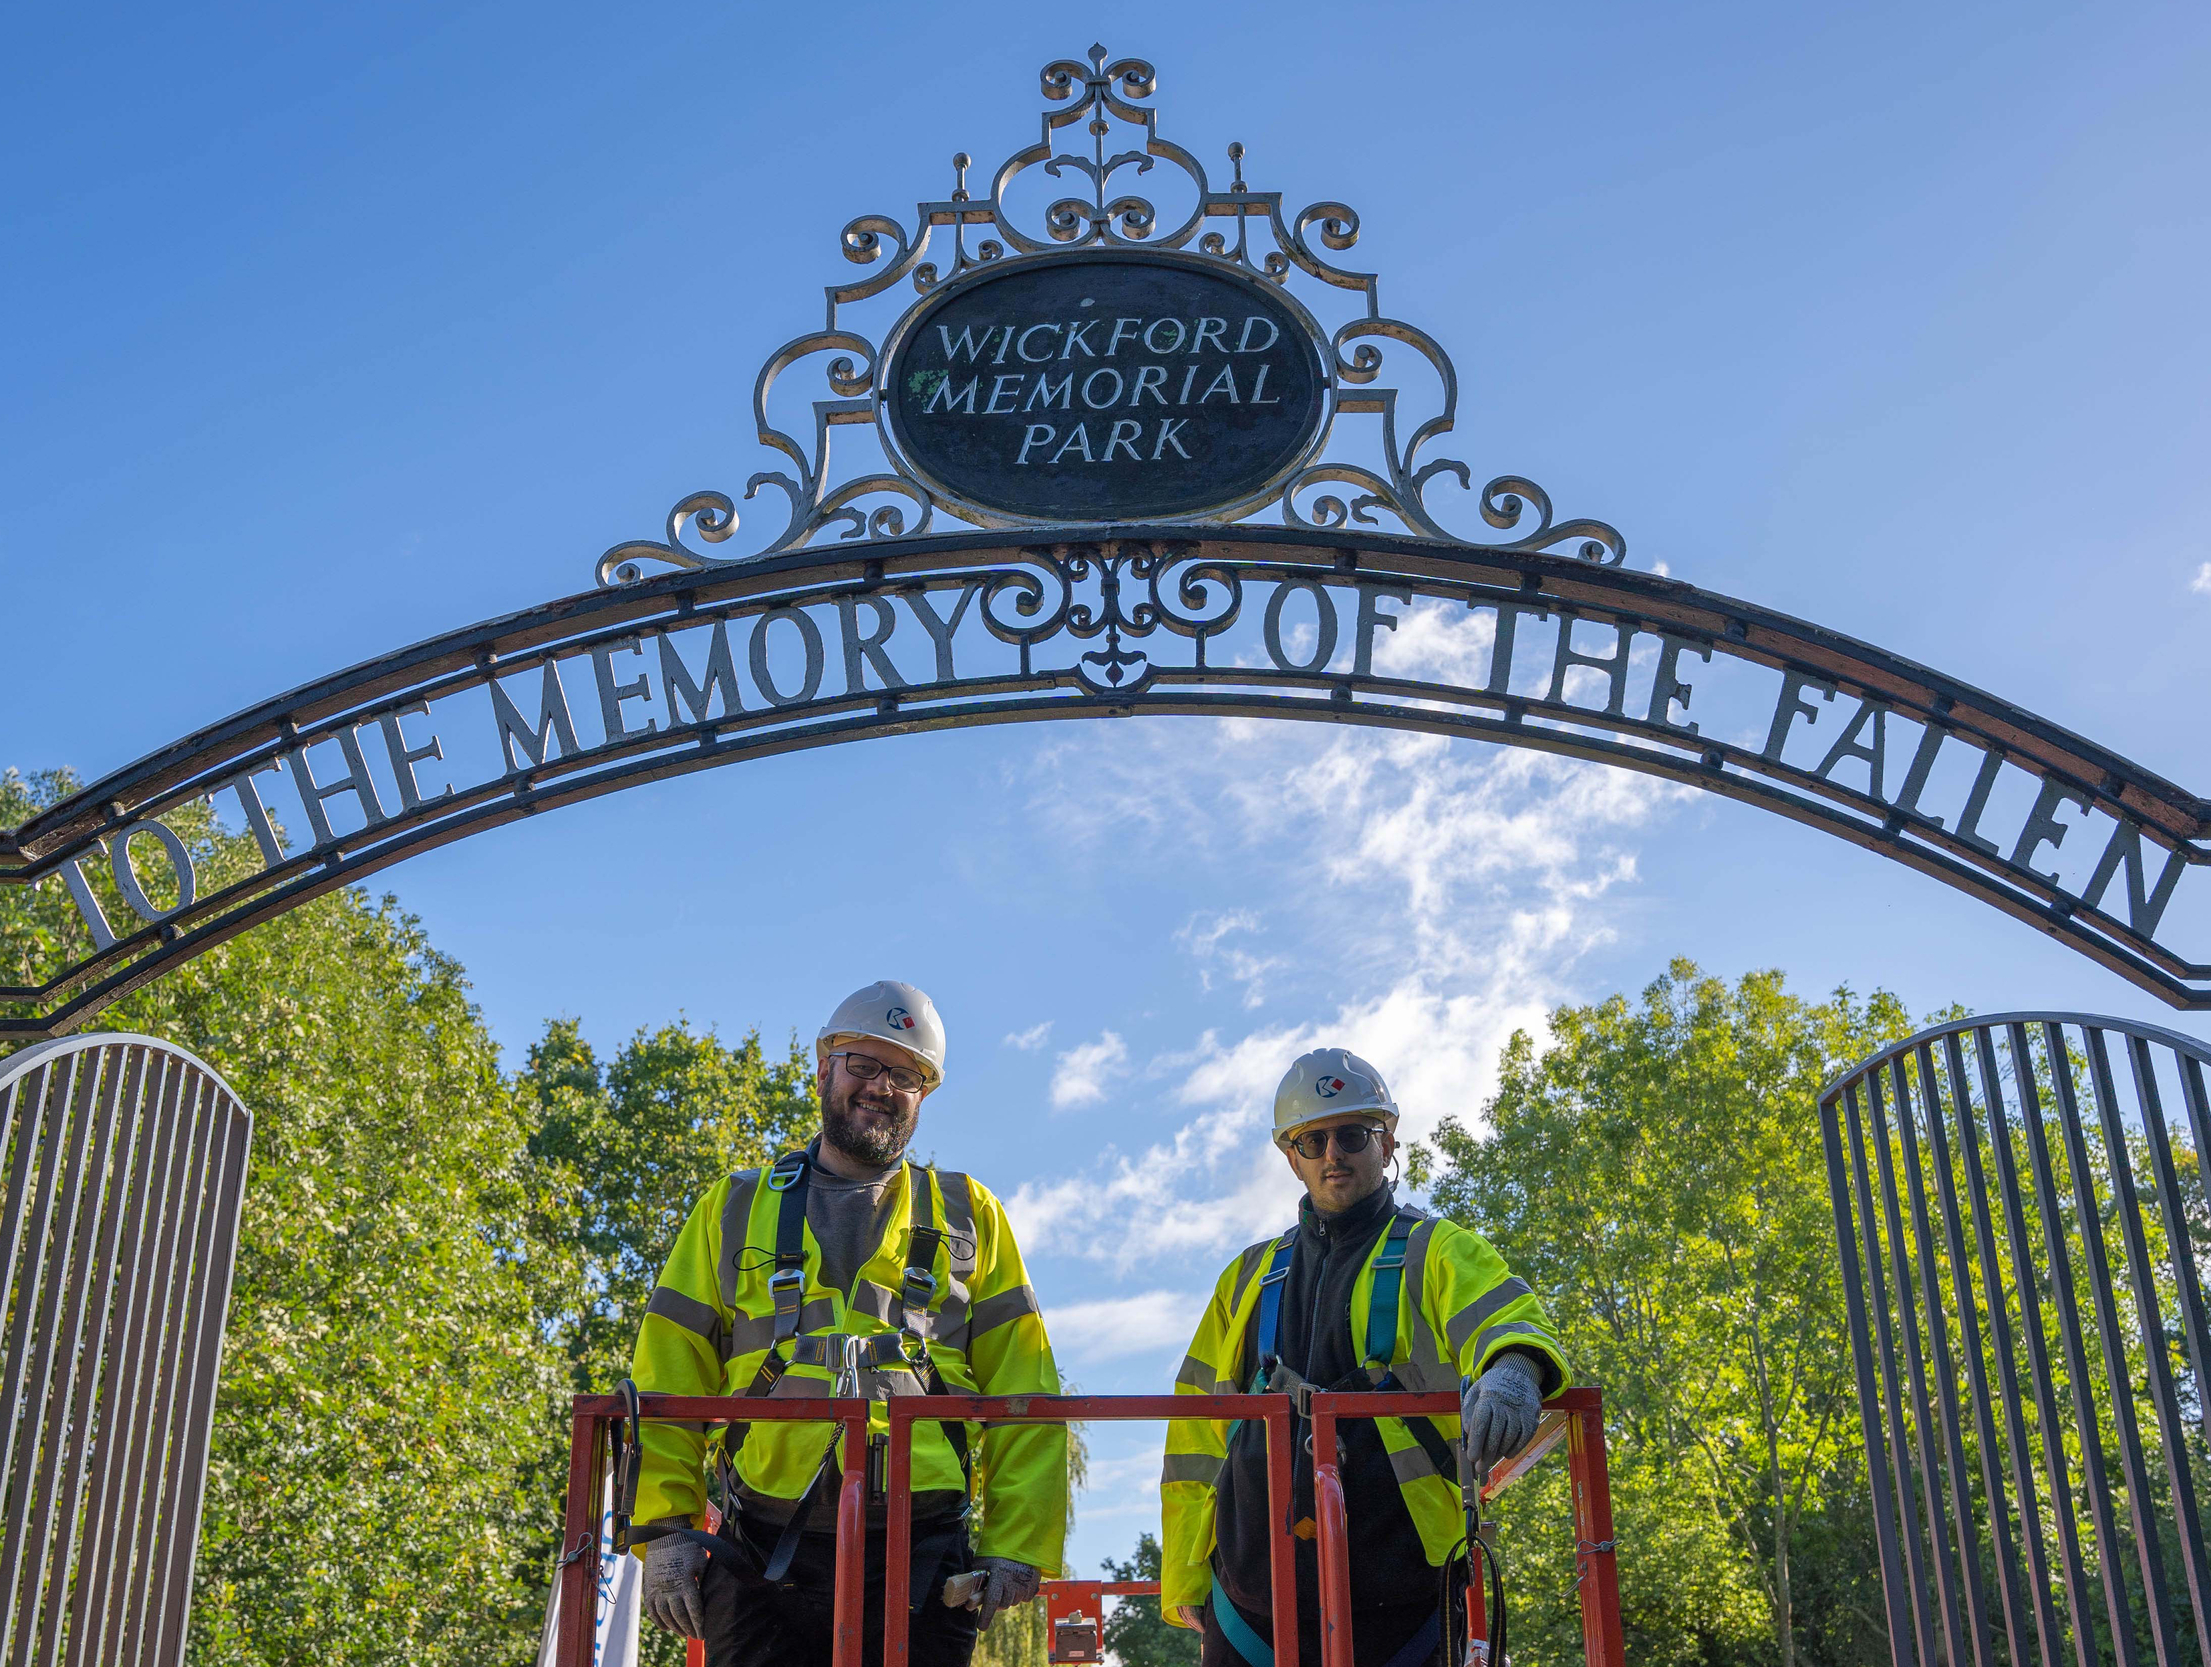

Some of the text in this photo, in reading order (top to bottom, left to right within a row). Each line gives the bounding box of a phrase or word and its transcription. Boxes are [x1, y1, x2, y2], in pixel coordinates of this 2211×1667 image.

[936, 316, 1280, 365] WICKFORD
[922, 364, 1280, 415] MEMORIAL
[1014, 417, 1192, 465] PARK
[31, 577, 2190, 950] TO THE MEMORY OF THE FALLEN
